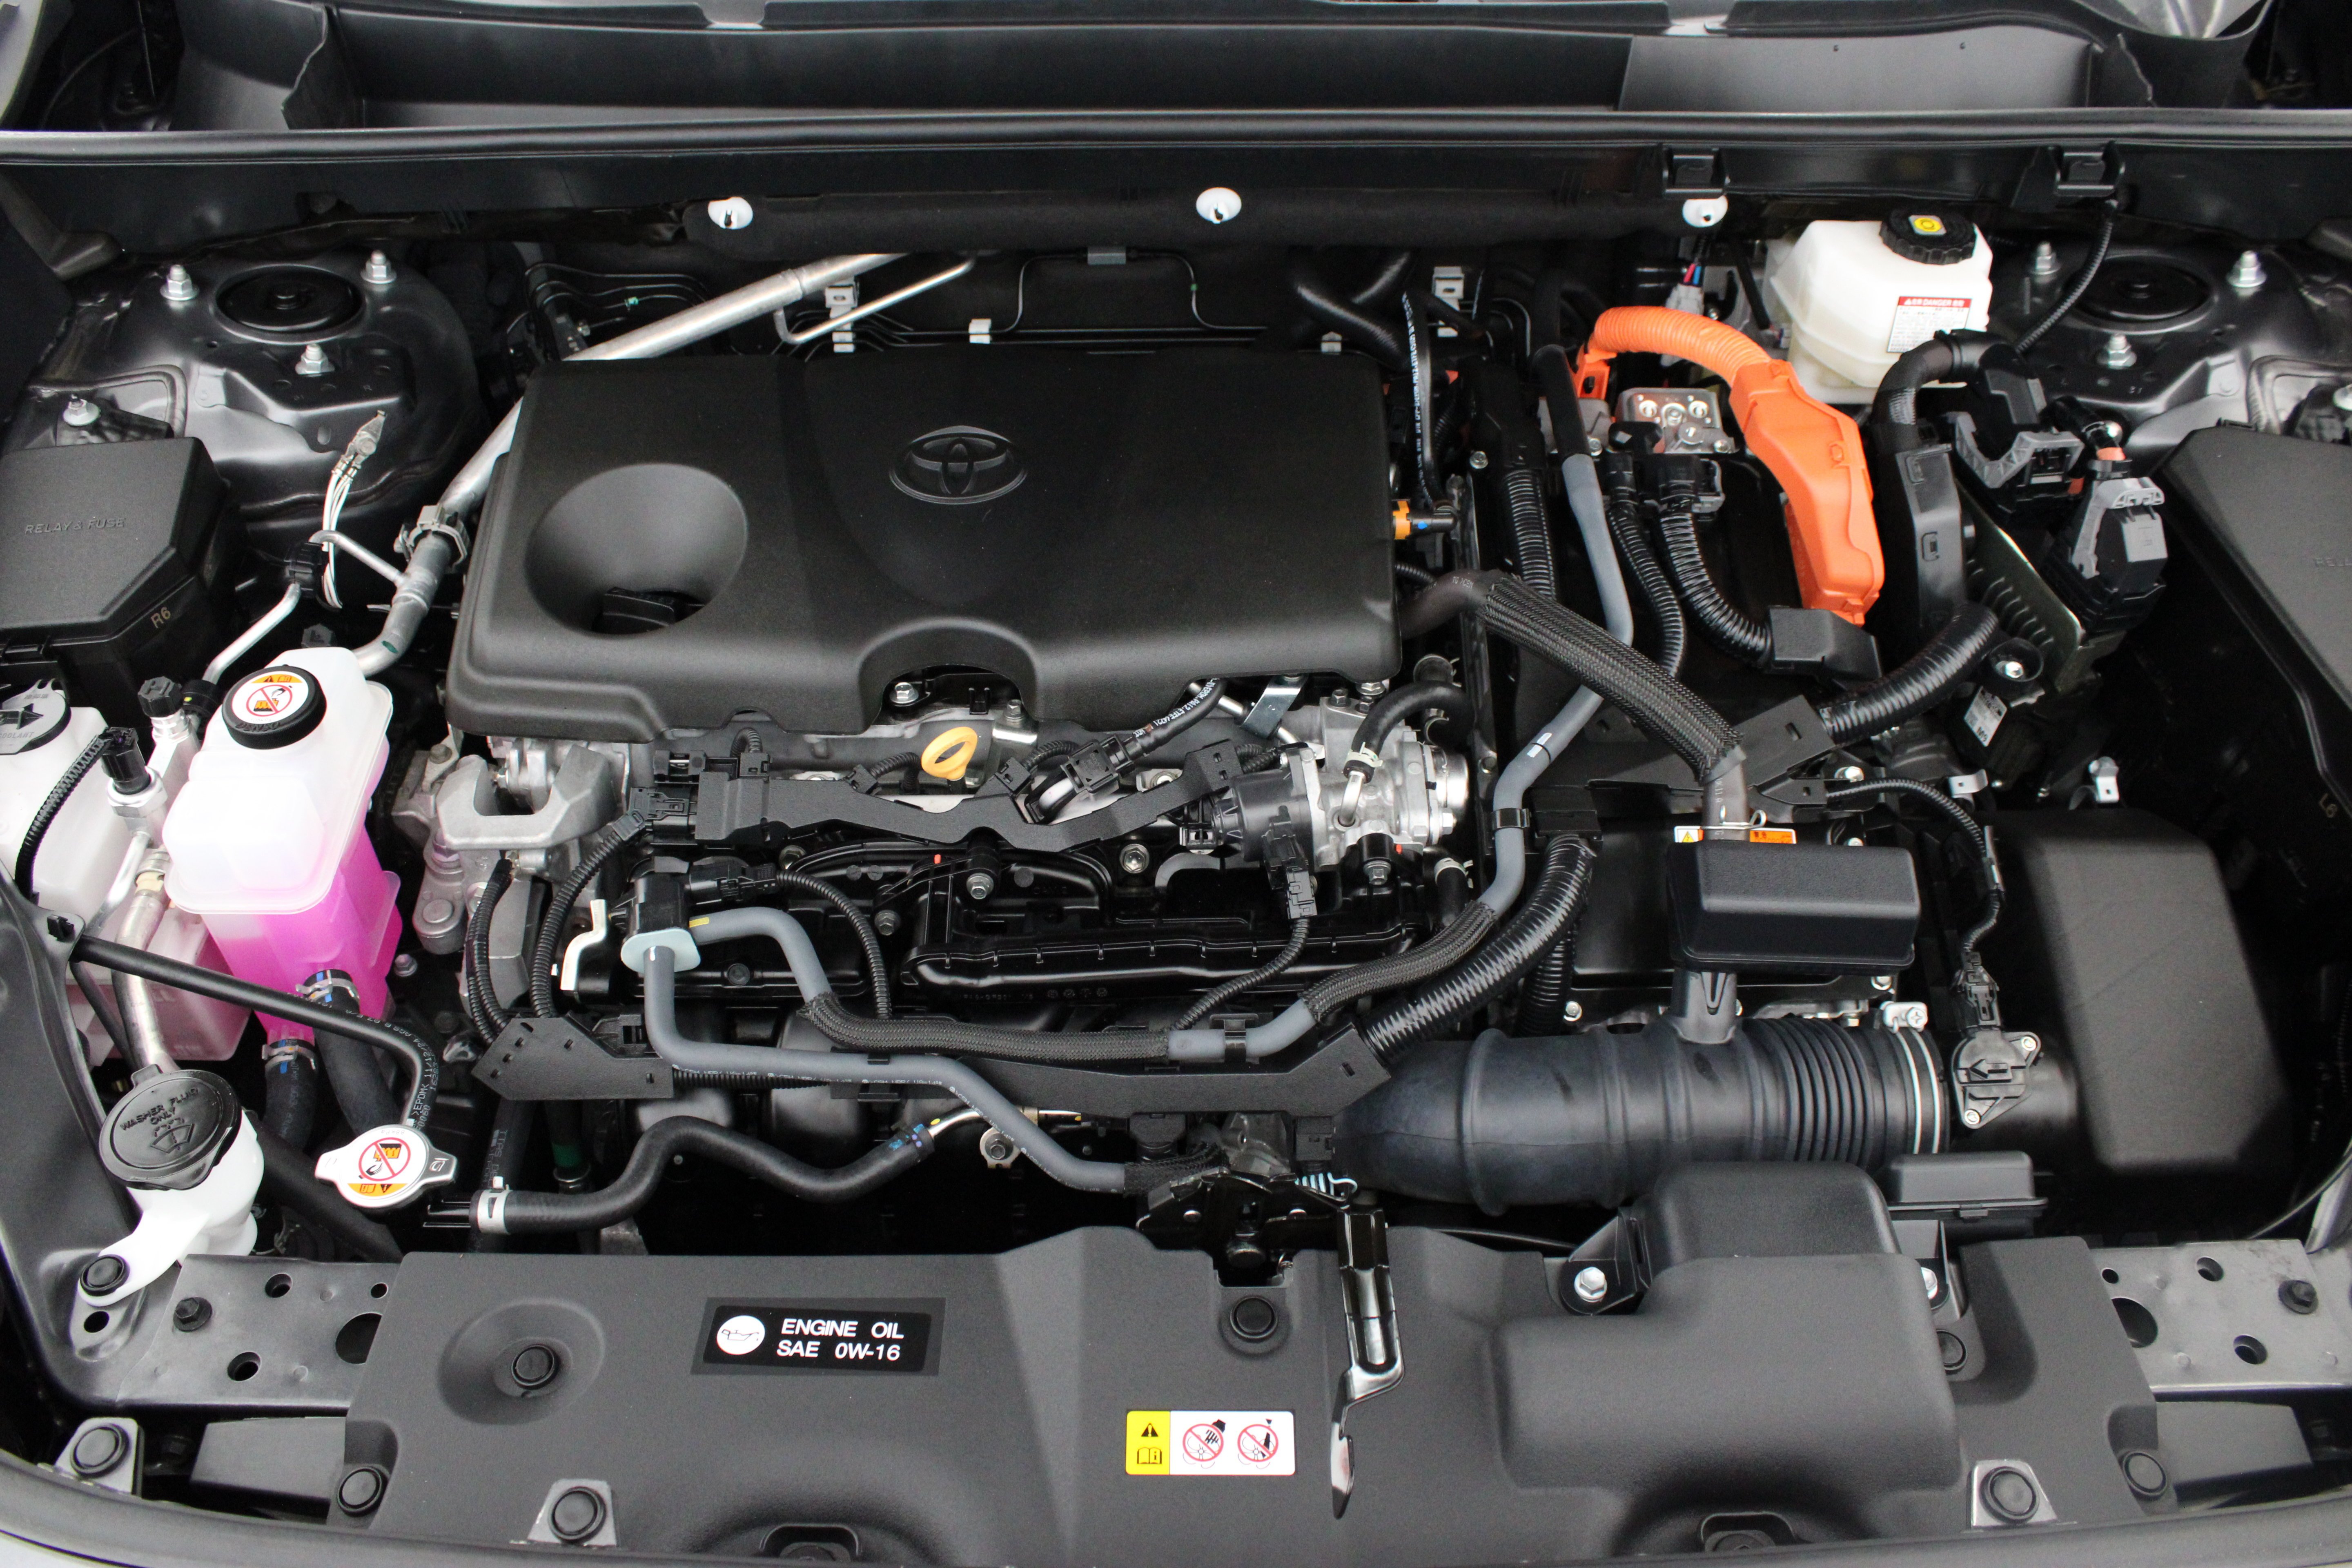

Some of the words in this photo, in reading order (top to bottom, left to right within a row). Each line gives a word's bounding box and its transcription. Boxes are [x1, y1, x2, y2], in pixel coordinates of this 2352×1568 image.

[24, 521, 72, 534] RELAY
[73, 521, 82, 530] &
[88, 517, 126, 530] FUSE
[150, 607, 171, 628] R6
[235, 722, 281, 733] DENSO
[120, 1104, 165, 1131] WASHER
[169, 1087, 199, 1106] FLUID
[150, 1106, 176, 1125] ONLY
[781, 1318, 858, 1337] ENGINE
[871, 1321, 904, 1339] OIL
[776, 1339, 821, 1358] SAE
[835, 1342, 901, 1361] 0W-16
